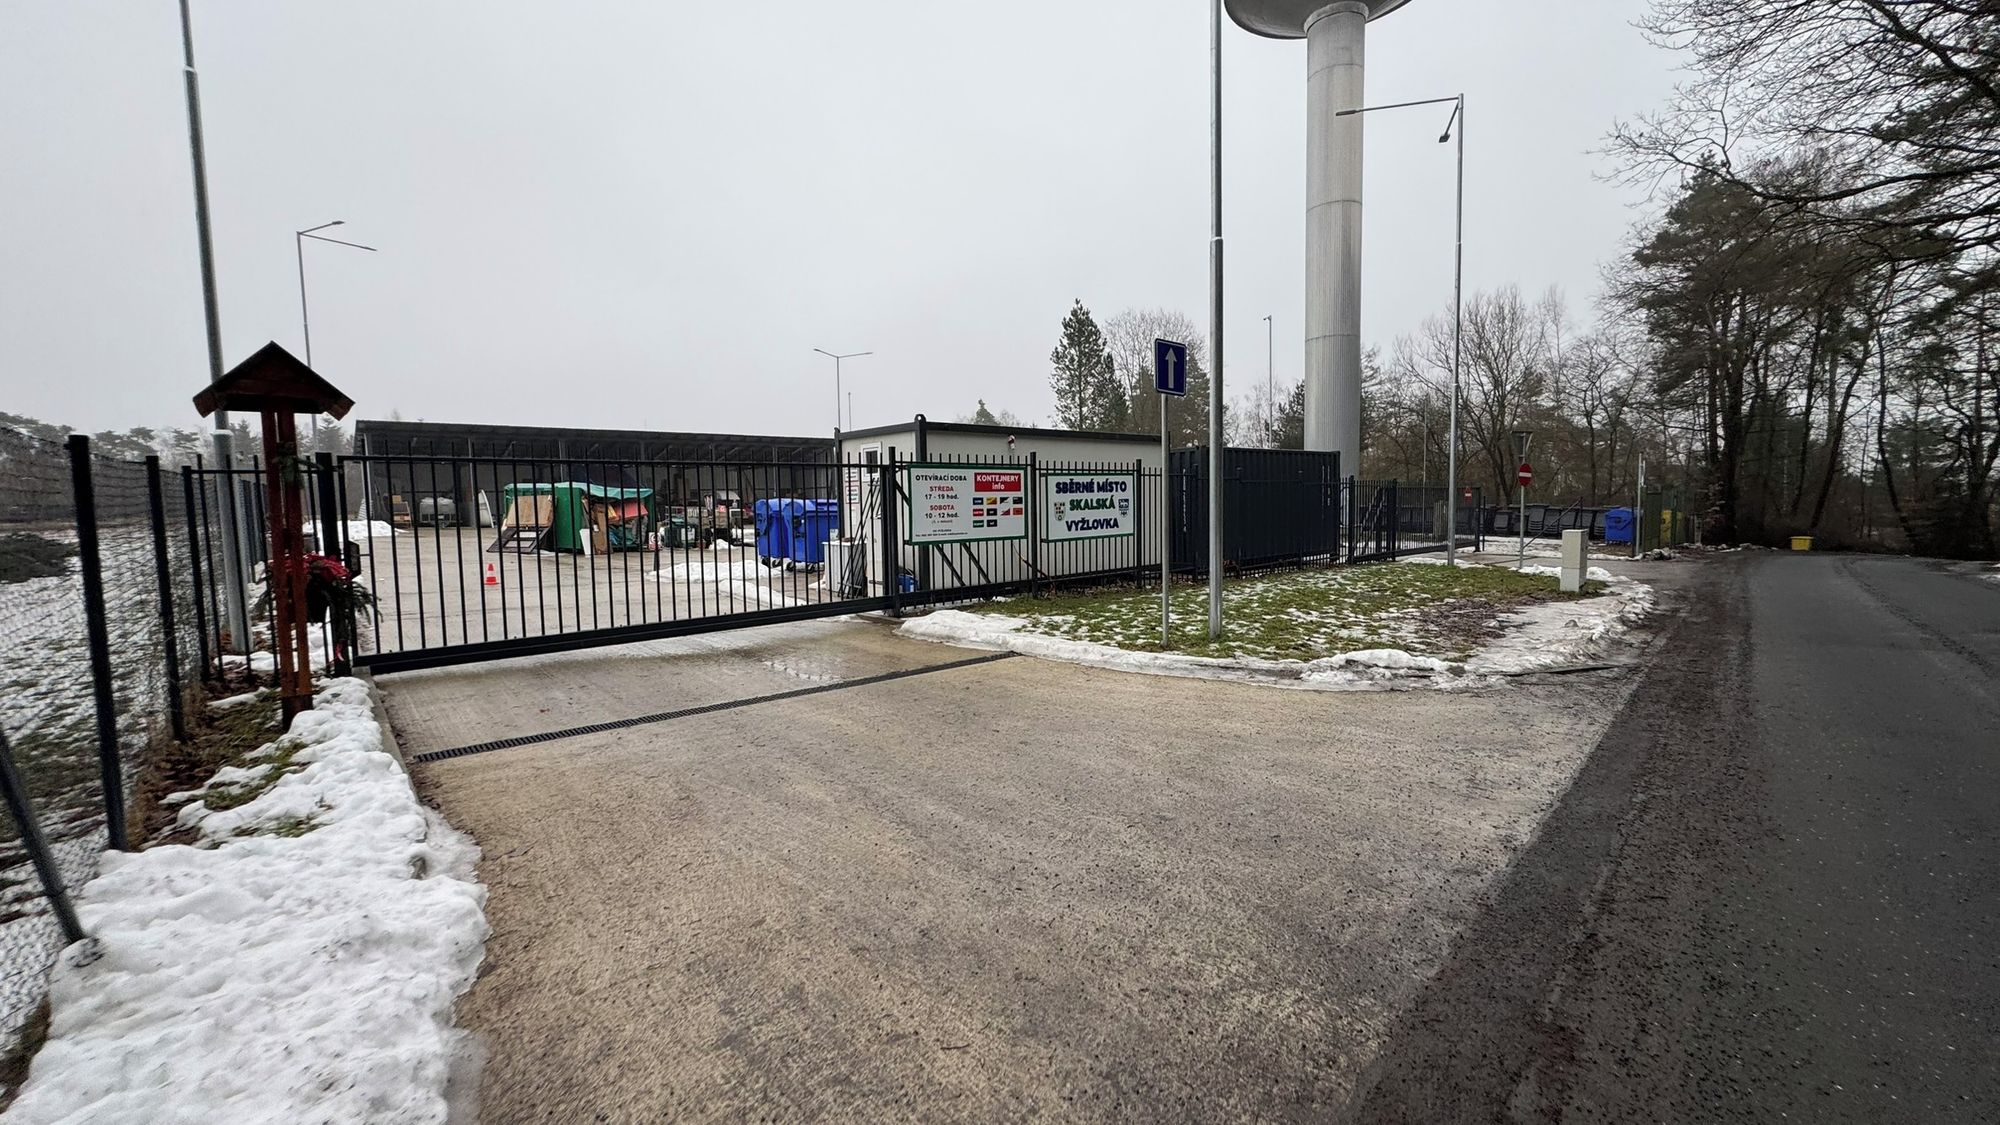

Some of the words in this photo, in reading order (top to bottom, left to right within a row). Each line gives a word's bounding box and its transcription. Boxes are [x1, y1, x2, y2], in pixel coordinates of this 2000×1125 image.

[915, 473, 950, 481] OTEVÍRACÍ
[976, 474, 1019, 482] KONTEJNERY
[929, 484, 954, 492] STŘEDA
[1055, 478, 1095, 494] SBĚRNÉ
[1097, 478, 1127, 493] MÍSTO
[1069, 495, 1116, 511] SKALSKÁ
[1065, 517, 1120, 532] VYŽLOVKA
